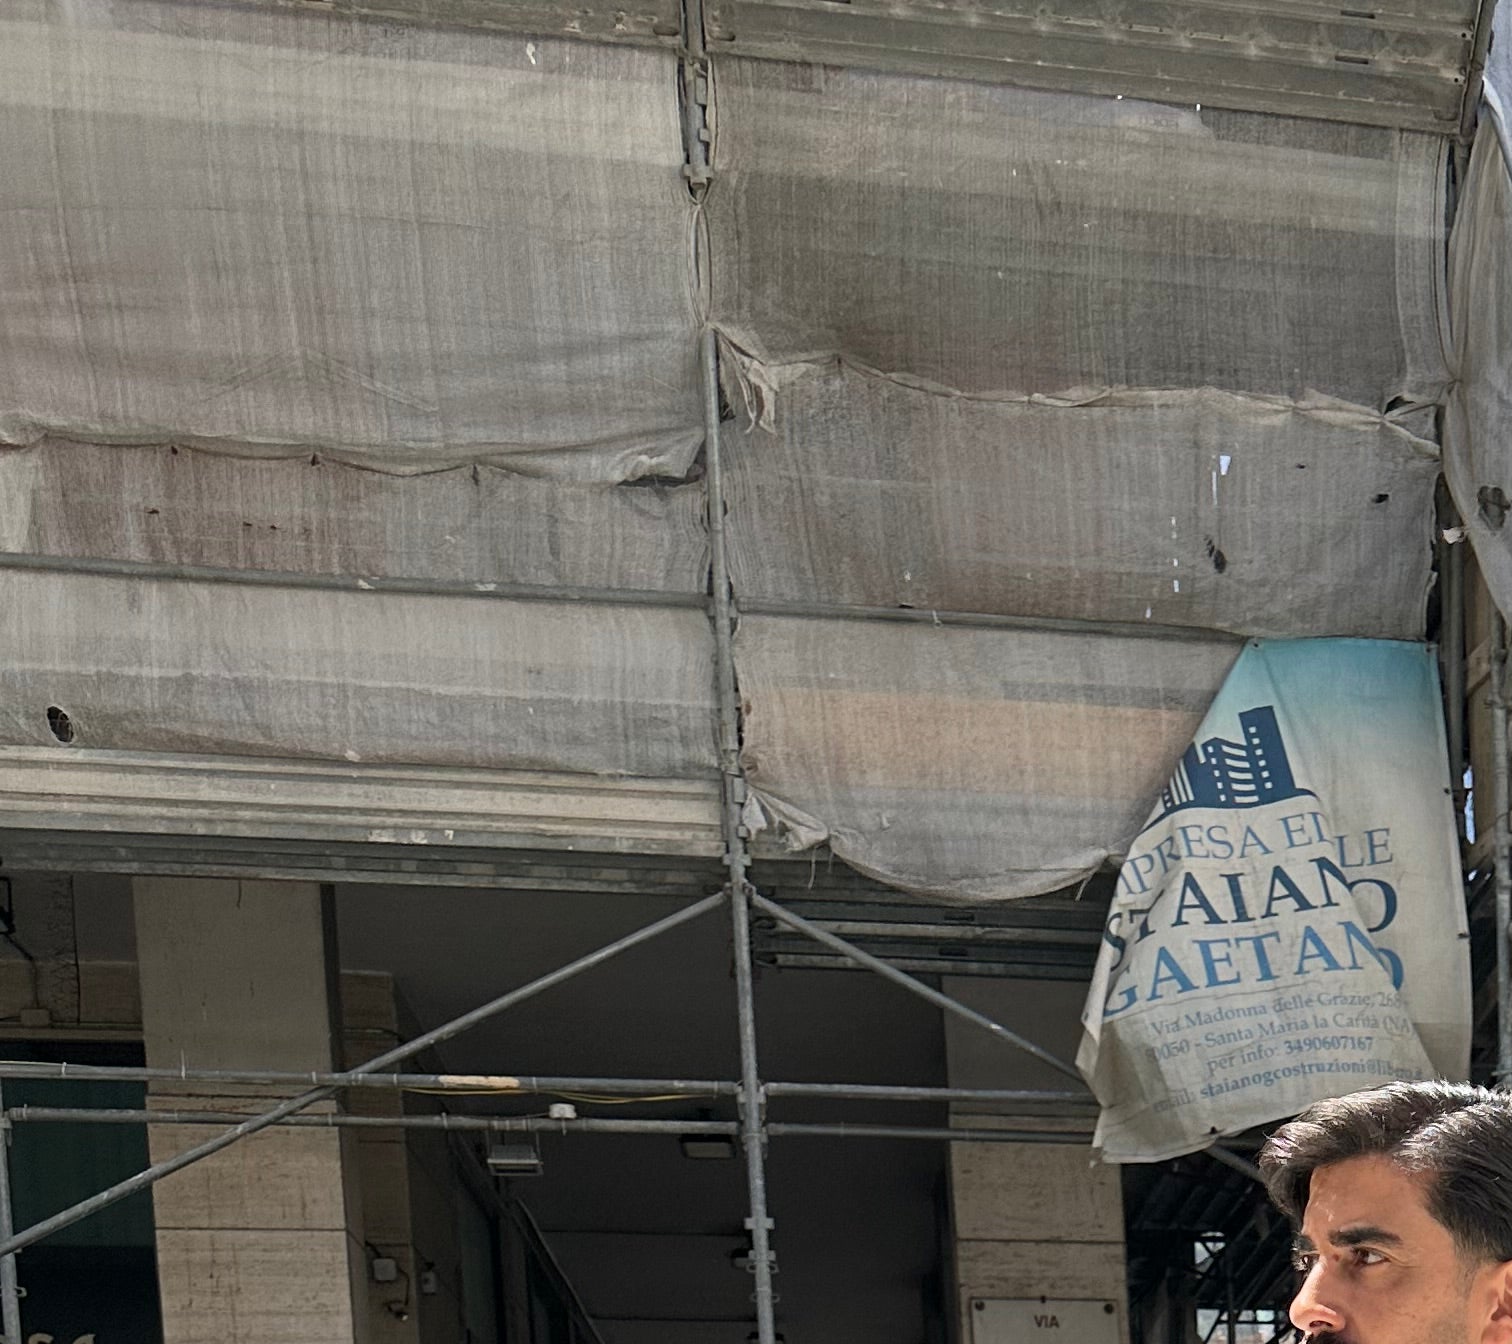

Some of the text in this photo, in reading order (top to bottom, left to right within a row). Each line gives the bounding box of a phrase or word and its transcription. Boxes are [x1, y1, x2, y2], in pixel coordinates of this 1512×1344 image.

[1184, 1004, 1267, 1028] Madonna
[1273, 991, 1314, 1013] delle
[1204, 1029, 1254, 1048] Santa
[1258, 1017, 1308, 1037] Maria
[1312, 1014, 1329, 1029] la
[1207, 1055, 1236, 1078] per
[1033, 1314, 1060, 1328] VIA
